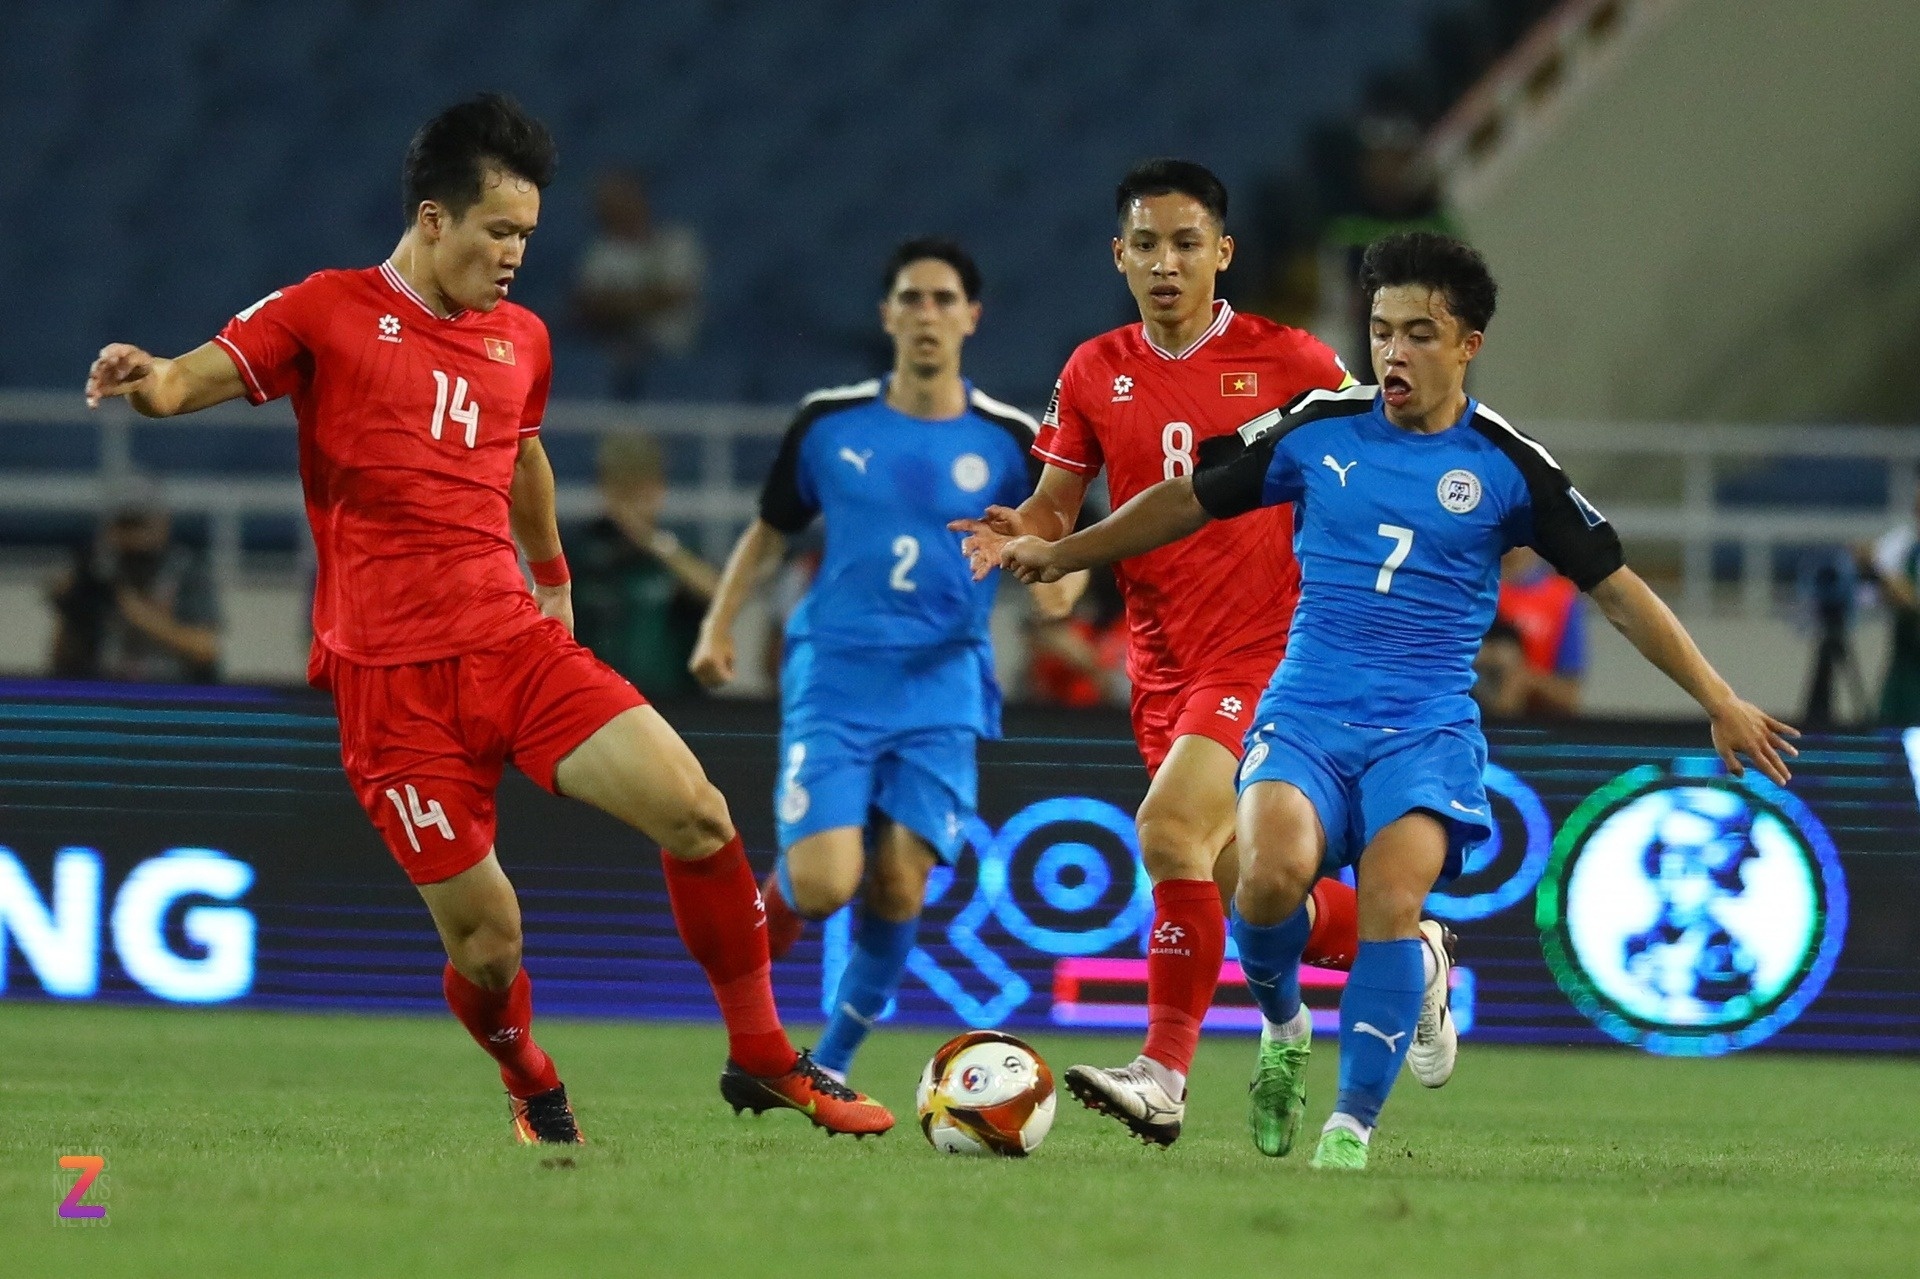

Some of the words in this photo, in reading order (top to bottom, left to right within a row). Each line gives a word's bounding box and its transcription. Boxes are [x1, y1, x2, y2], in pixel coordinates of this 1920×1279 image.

[430, 370, 479, 449] 14
[1161, 421, 1194, 481] 8
[1448, 492, 1471, 503] PFF
[889, 535, 920, 592] 2
[1375, 523, 1414, 595] 7
[385, 783, 456, 853] 14
[0, 846, 257, 1003] NG
